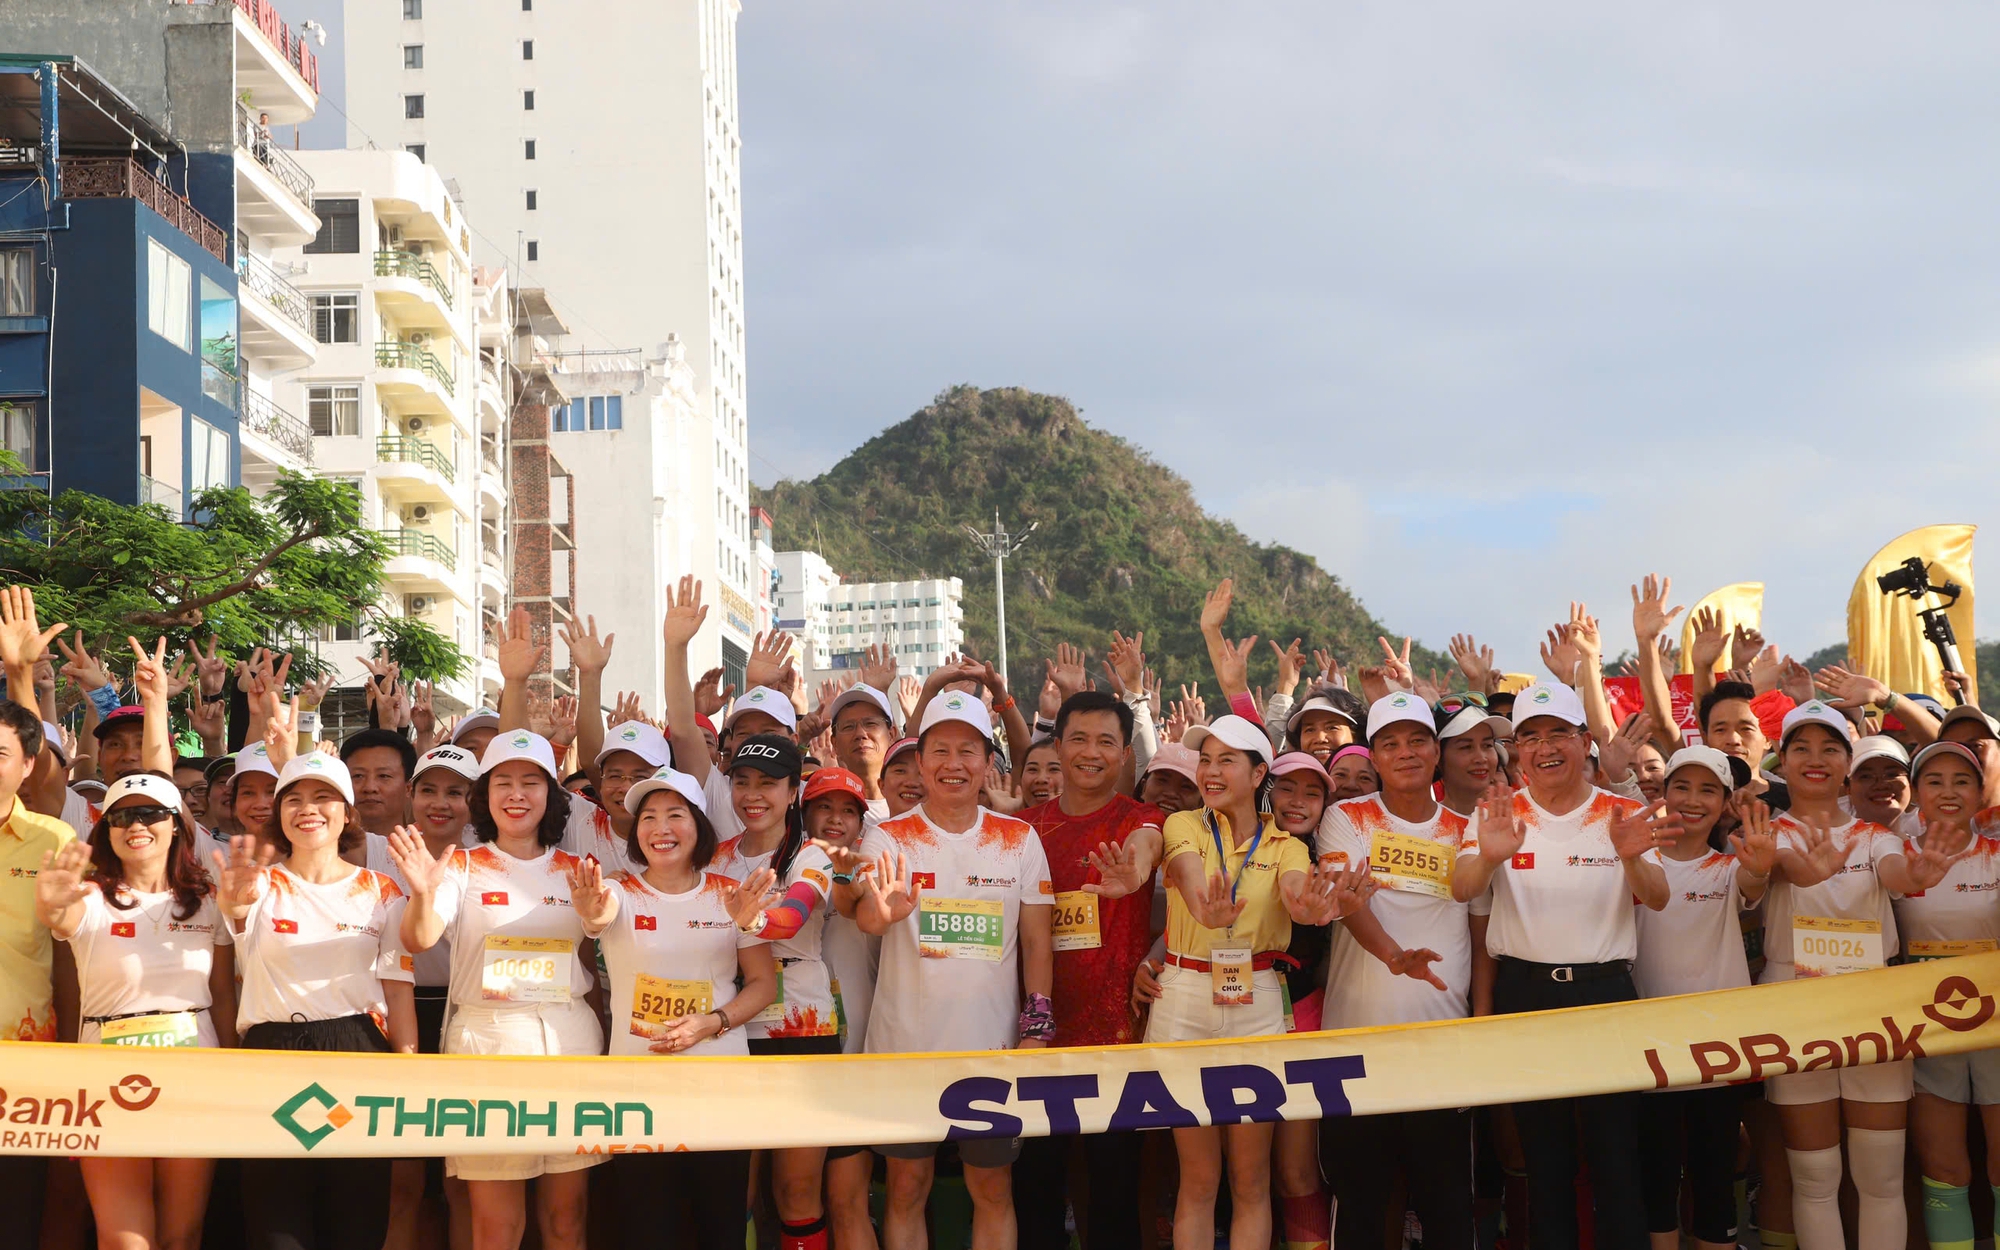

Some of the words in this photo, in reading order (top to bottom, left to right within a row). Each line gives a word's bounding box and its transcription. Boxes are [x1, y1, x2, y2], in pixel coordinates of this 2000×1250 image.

[1379, 846, 1439, 872] 52555
[929, 913, 987, 934] 15888
[1051, 906, 1085, 927] 266
[1803, 937, 1865, 958] 00026
[493, 957, 555, 979] 00098
[641, 992, 697, 1018] 52186
[939, 1055, 1366, 1140] START
[574, 1101, 653, 1137] AN
